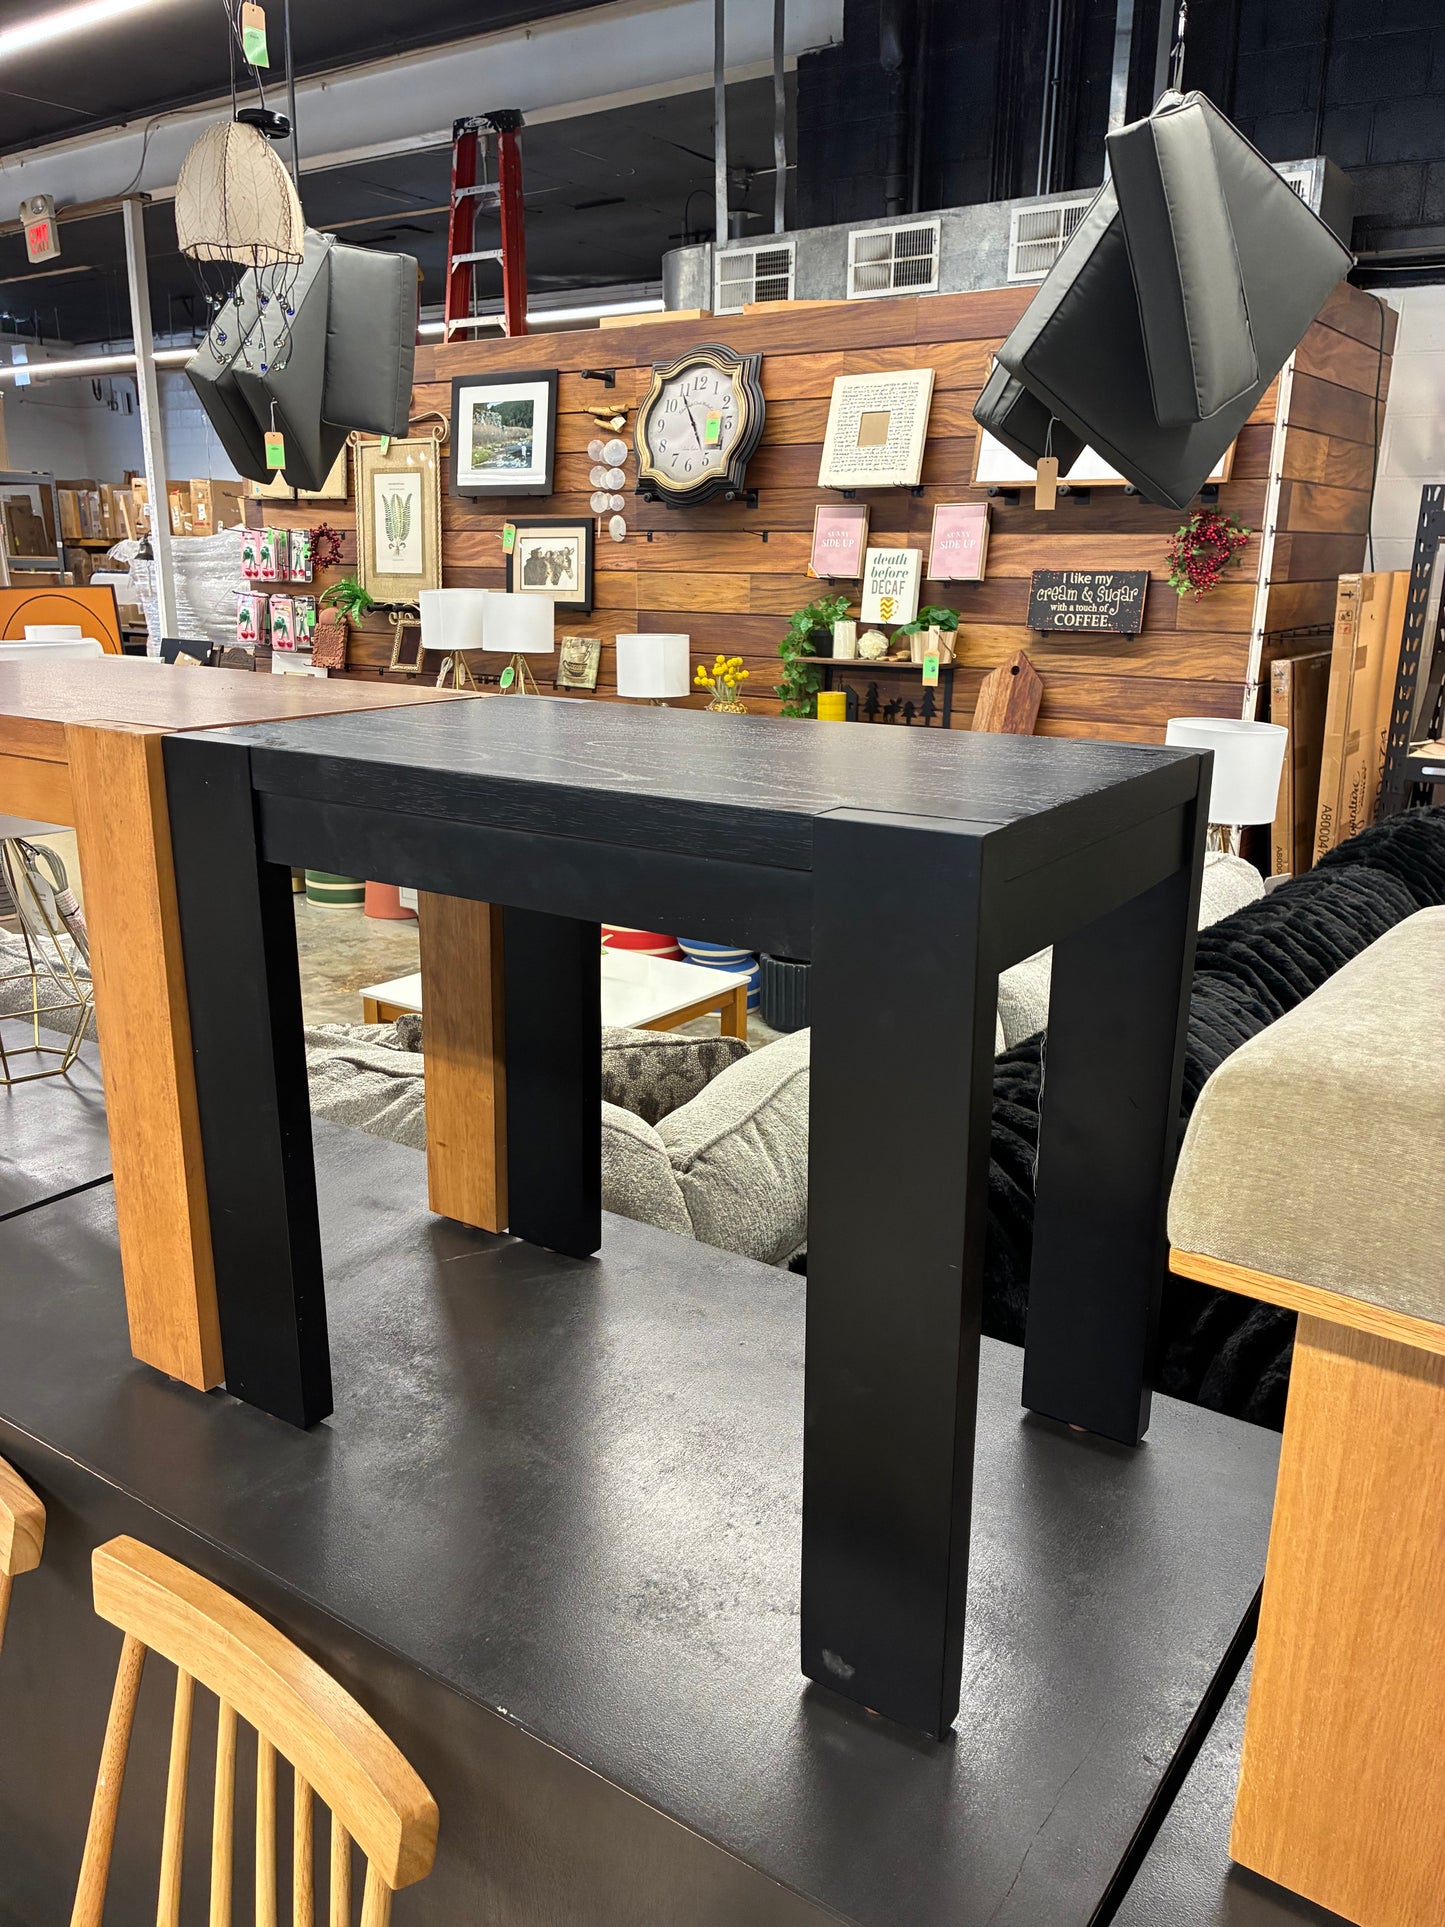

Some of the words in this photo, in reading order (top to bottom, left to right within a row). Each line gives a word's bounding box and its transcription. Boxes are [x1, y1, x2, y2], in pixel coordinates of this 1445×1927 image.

[680, 383, 690, 397] 11
[693, 376, 708, 390] 12
[713, 381, 719, 395] 1
[665, 399, 678, 413] 10
[722, 395, 731, 409] 2
[658, 419, 665, 433] 9
[724, 415, 733, 430] 3
[659, 439, 667, 453] 8
[671, 453, 680, 467] 7
[684, 458, 692, 472] 6
[702, 452, 709, 466] 5
[821, 539, 840, 548] SIDE
[843, 539, 854, 548] UP
[940, 540, 961, 549] SIDE
[964, 540, 976, 549] UP
[874, 553, 907, 565] death
[871, 566, 909, 580] before
[1063, 573, 1067, 583] I
[1070, 572, 1092, 584] like
[1095, 575, 1113, 586] my
[871, 580, 906, 595] DECAF
[1036, 585, 1078, 601] cream
[1081, 586, 1094, 603] &
[1050, 603, 1067, 611] with
[1076, 604, 1097, 612] touch
[1099, 603, 1109, 612] of
[1054, 613, 1112, 626] COFFEE.
[1317, 804, 1332, 857] A800047
